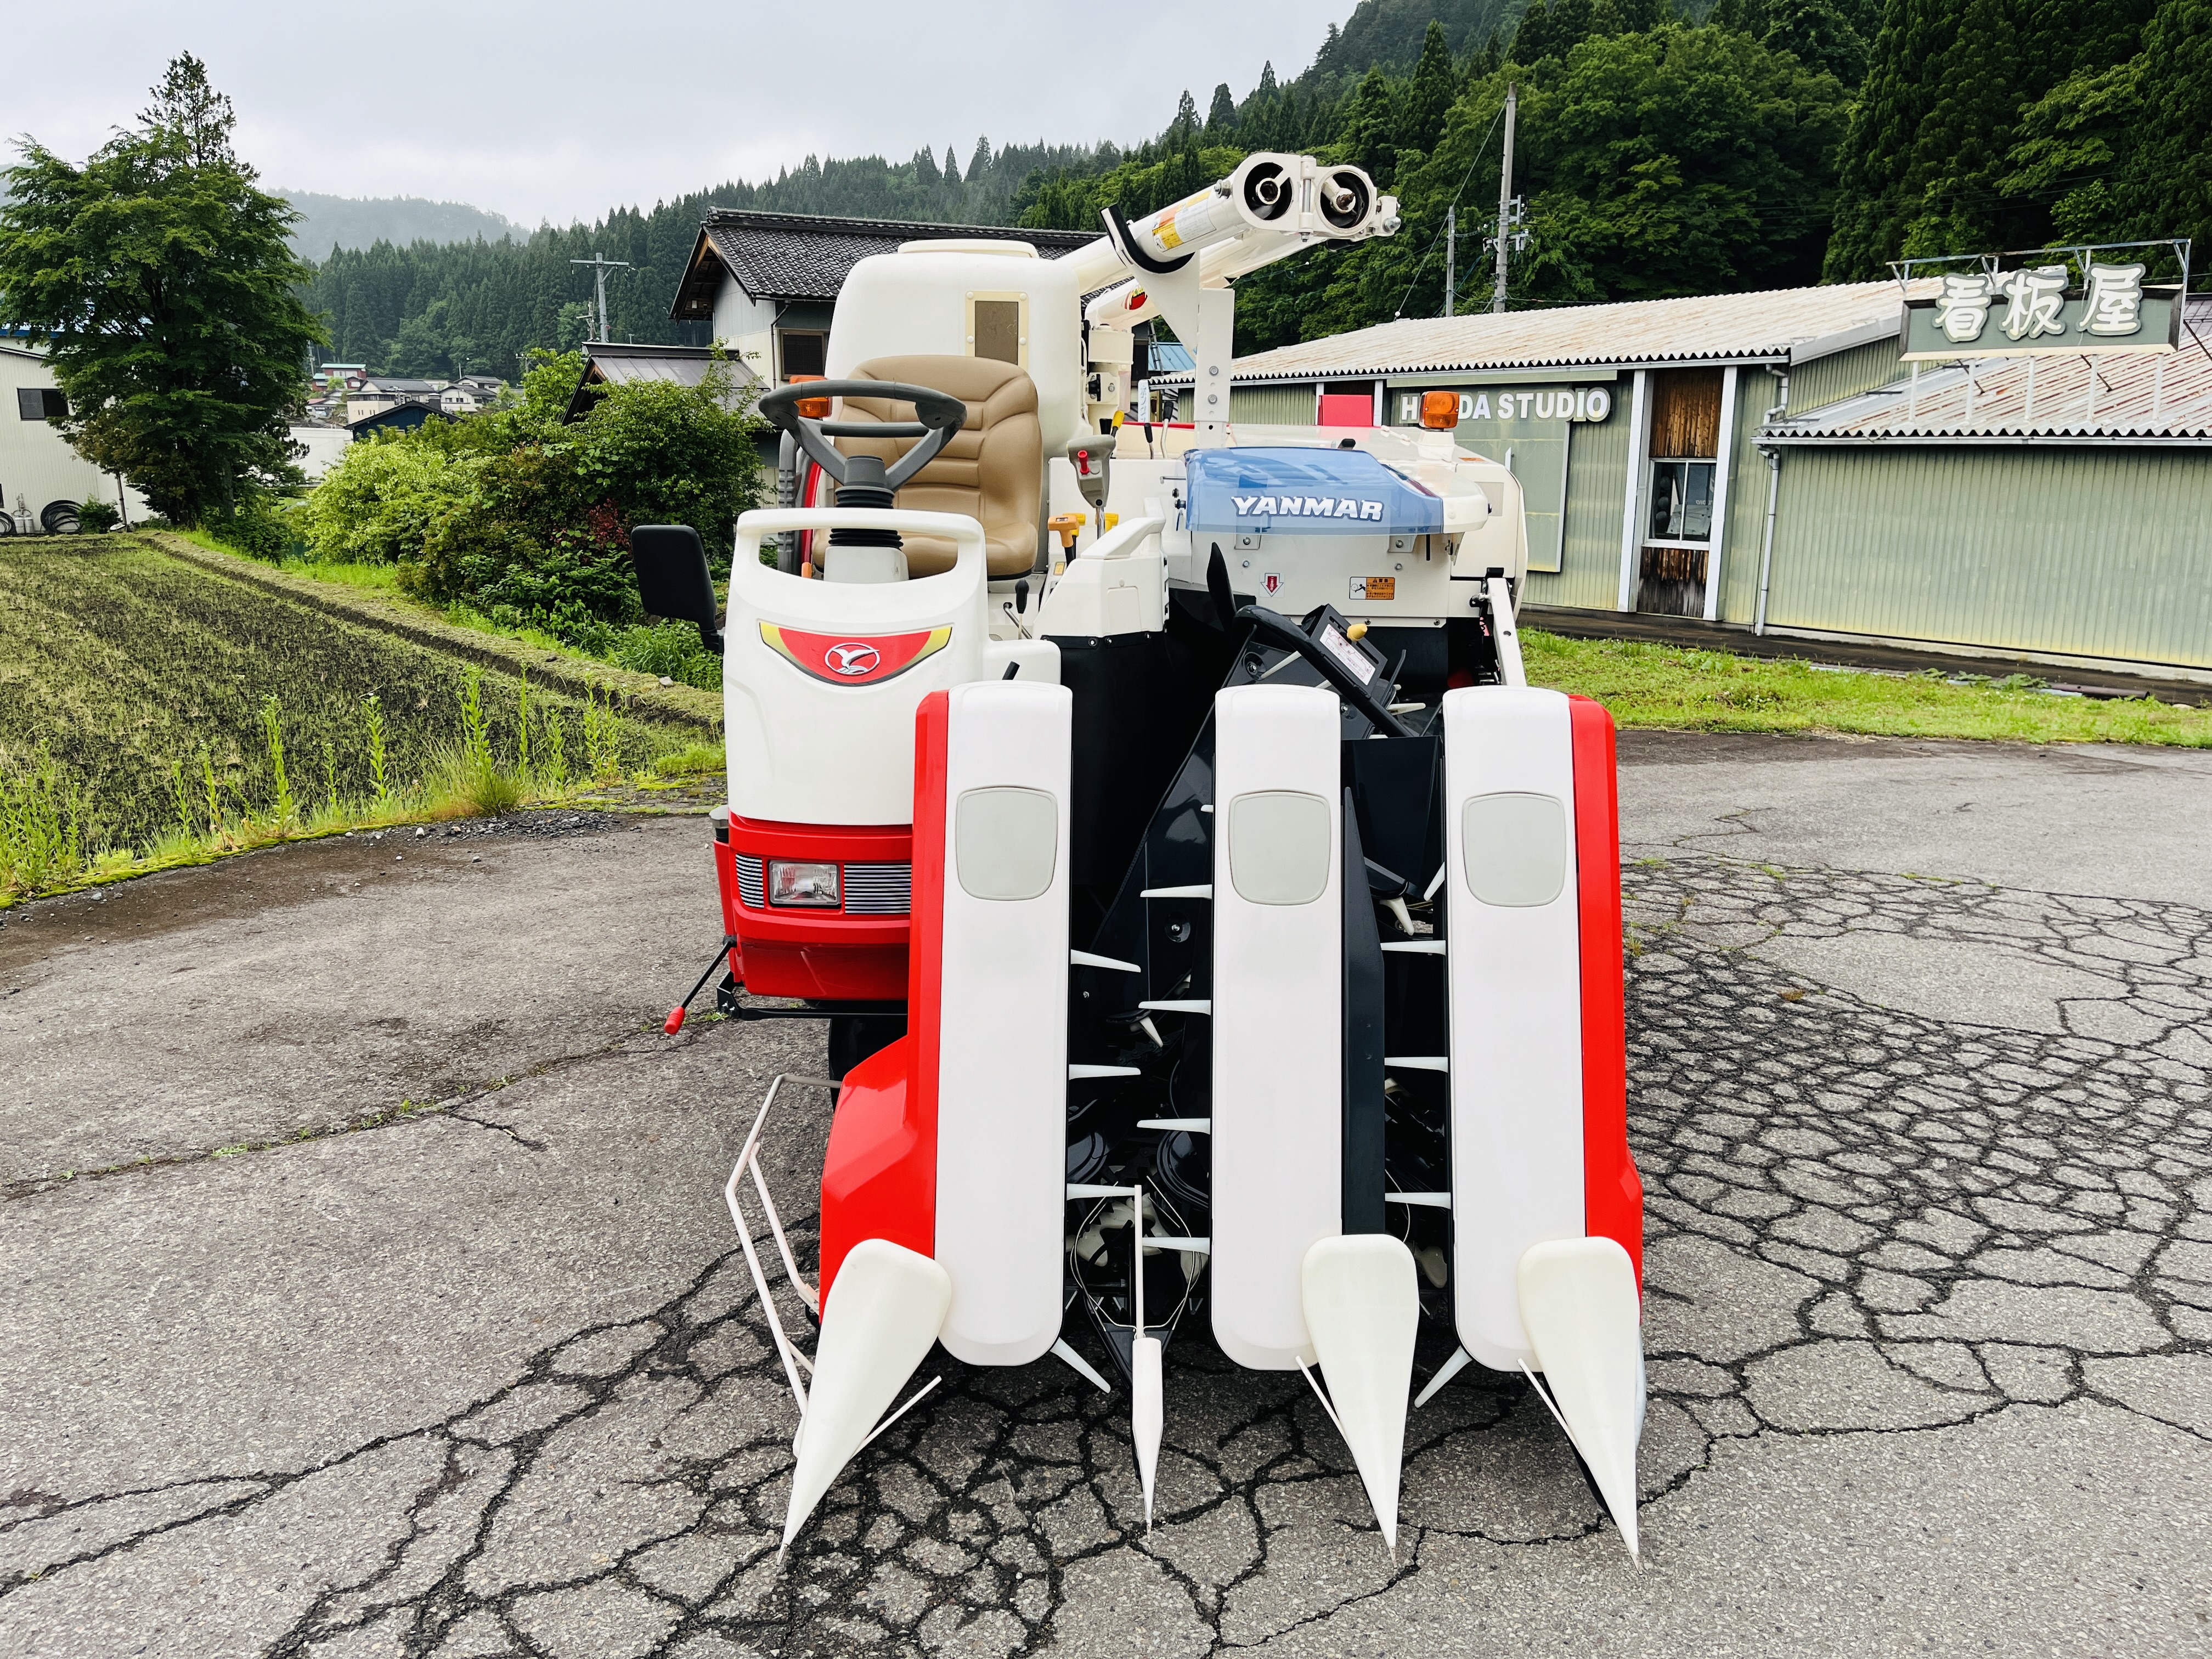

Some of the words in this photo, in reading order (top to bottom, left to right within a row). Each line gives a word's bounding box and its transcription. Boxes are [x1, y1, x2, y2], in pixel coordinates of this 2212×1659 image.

[1933, 264, 2142, 340] 看板屋
[1401, 393, 1491, 421] HDA
[1497, 390, 1609, 419] STUDIO
[1231, 495, 1384, 521] YANMAR
